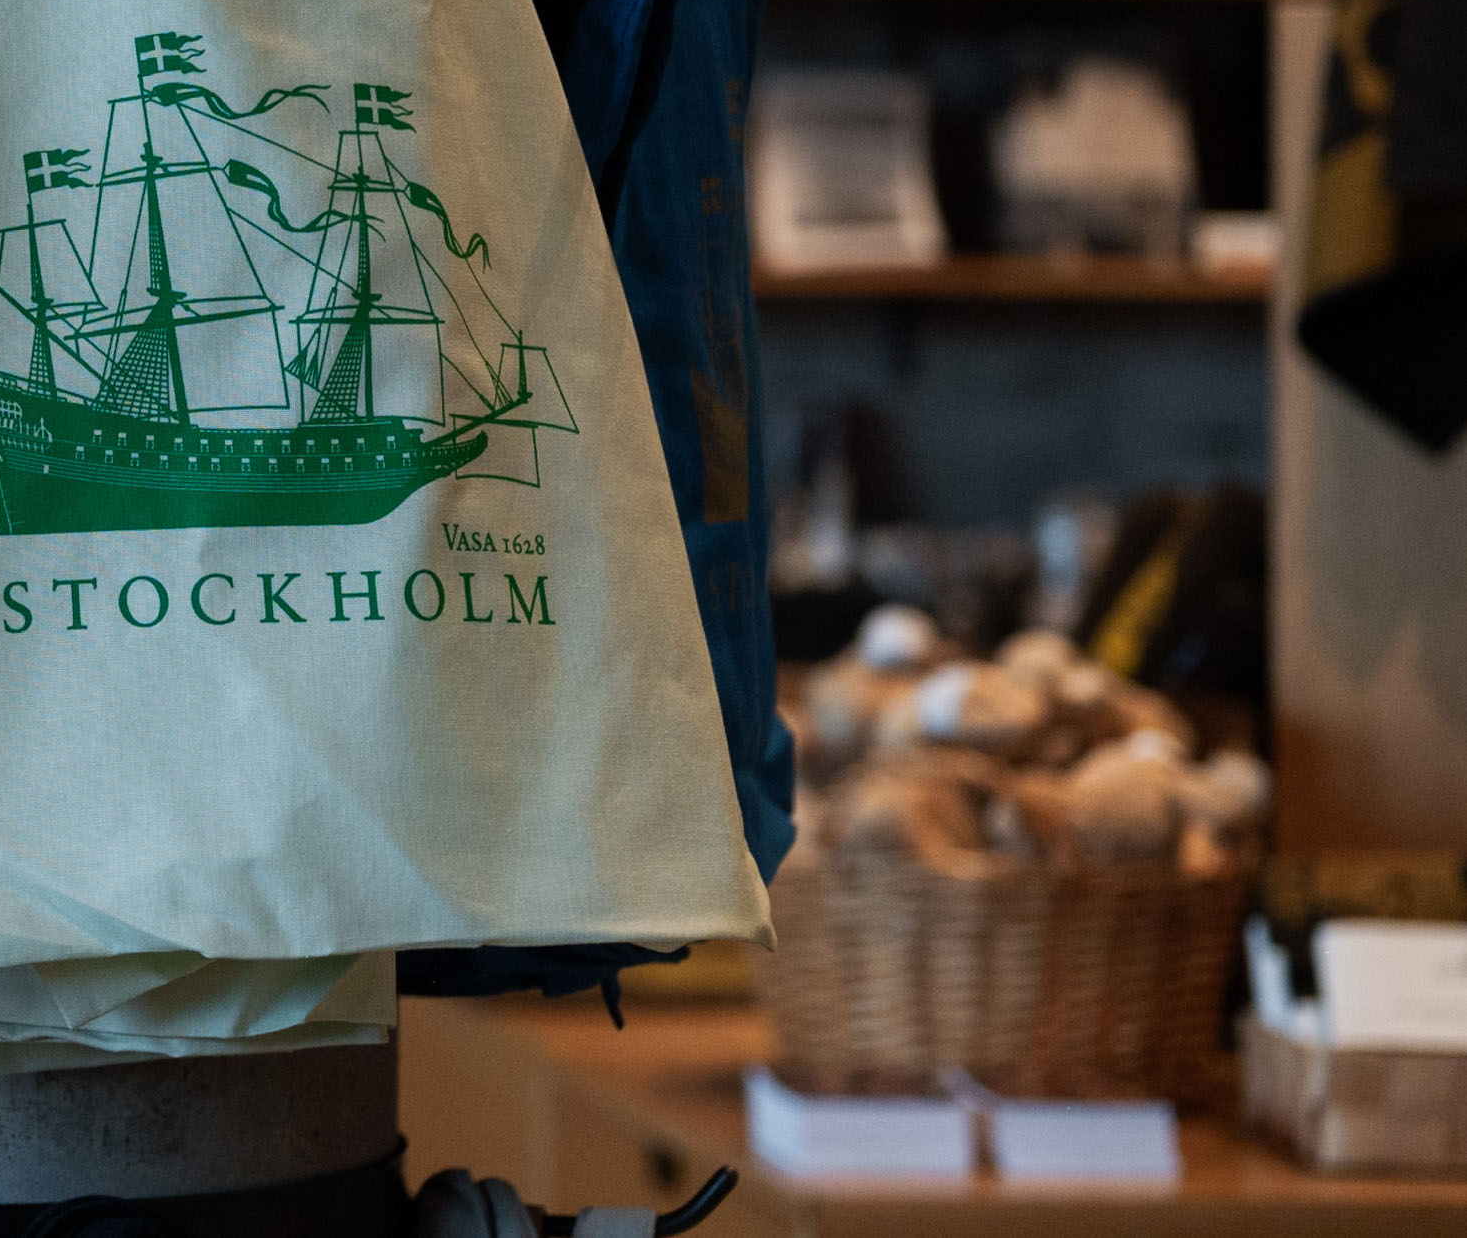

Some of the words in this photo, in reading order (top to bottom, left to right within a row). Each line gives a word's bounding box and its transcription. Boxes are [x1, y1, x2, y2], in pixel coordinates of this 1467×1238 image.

[441, 522, 497, 552] VASA
[502, 533, 547, 556] 1628
[2, 568, 557, 634] STOCKHOLM
